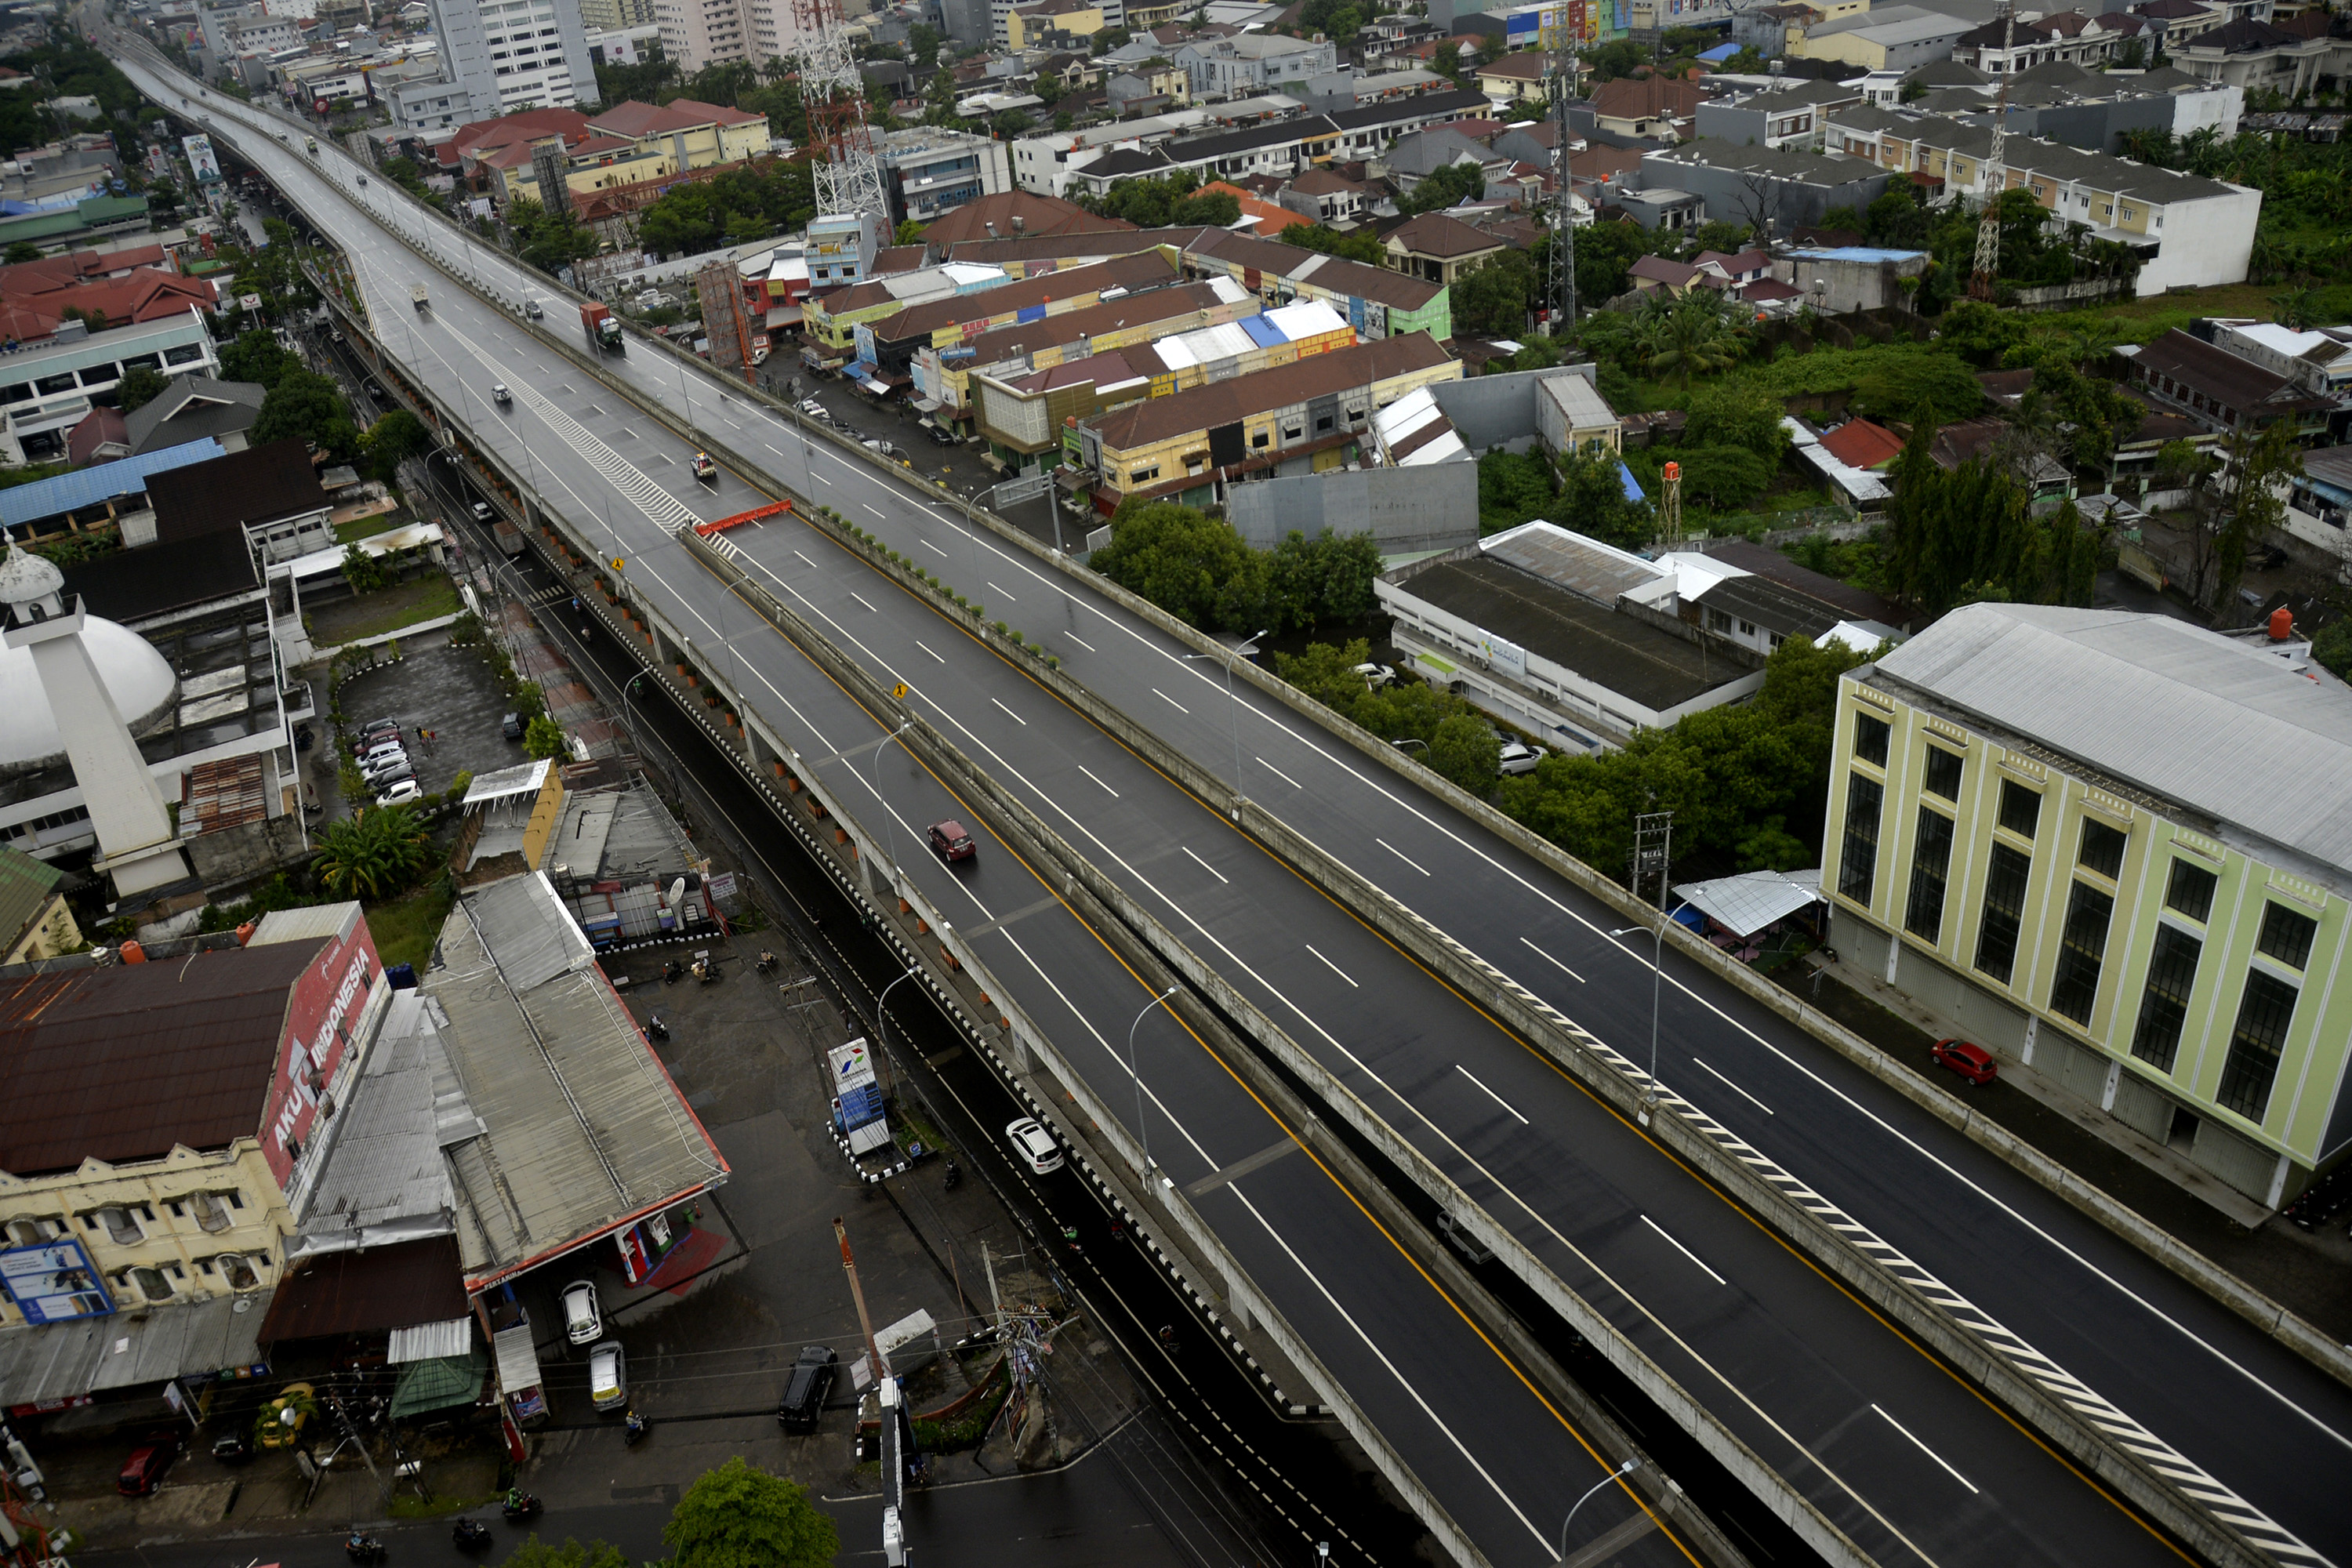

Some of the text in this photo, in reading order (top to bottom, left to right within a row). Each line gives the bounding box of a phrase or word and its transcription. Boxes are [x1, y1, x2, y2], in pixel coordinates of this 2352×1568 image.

[274, 1087, 303, 1152] AKU
[310, 946, 369, 1069] INDONESIA
[484, 1270, 523, 1290] PERTAMINA
